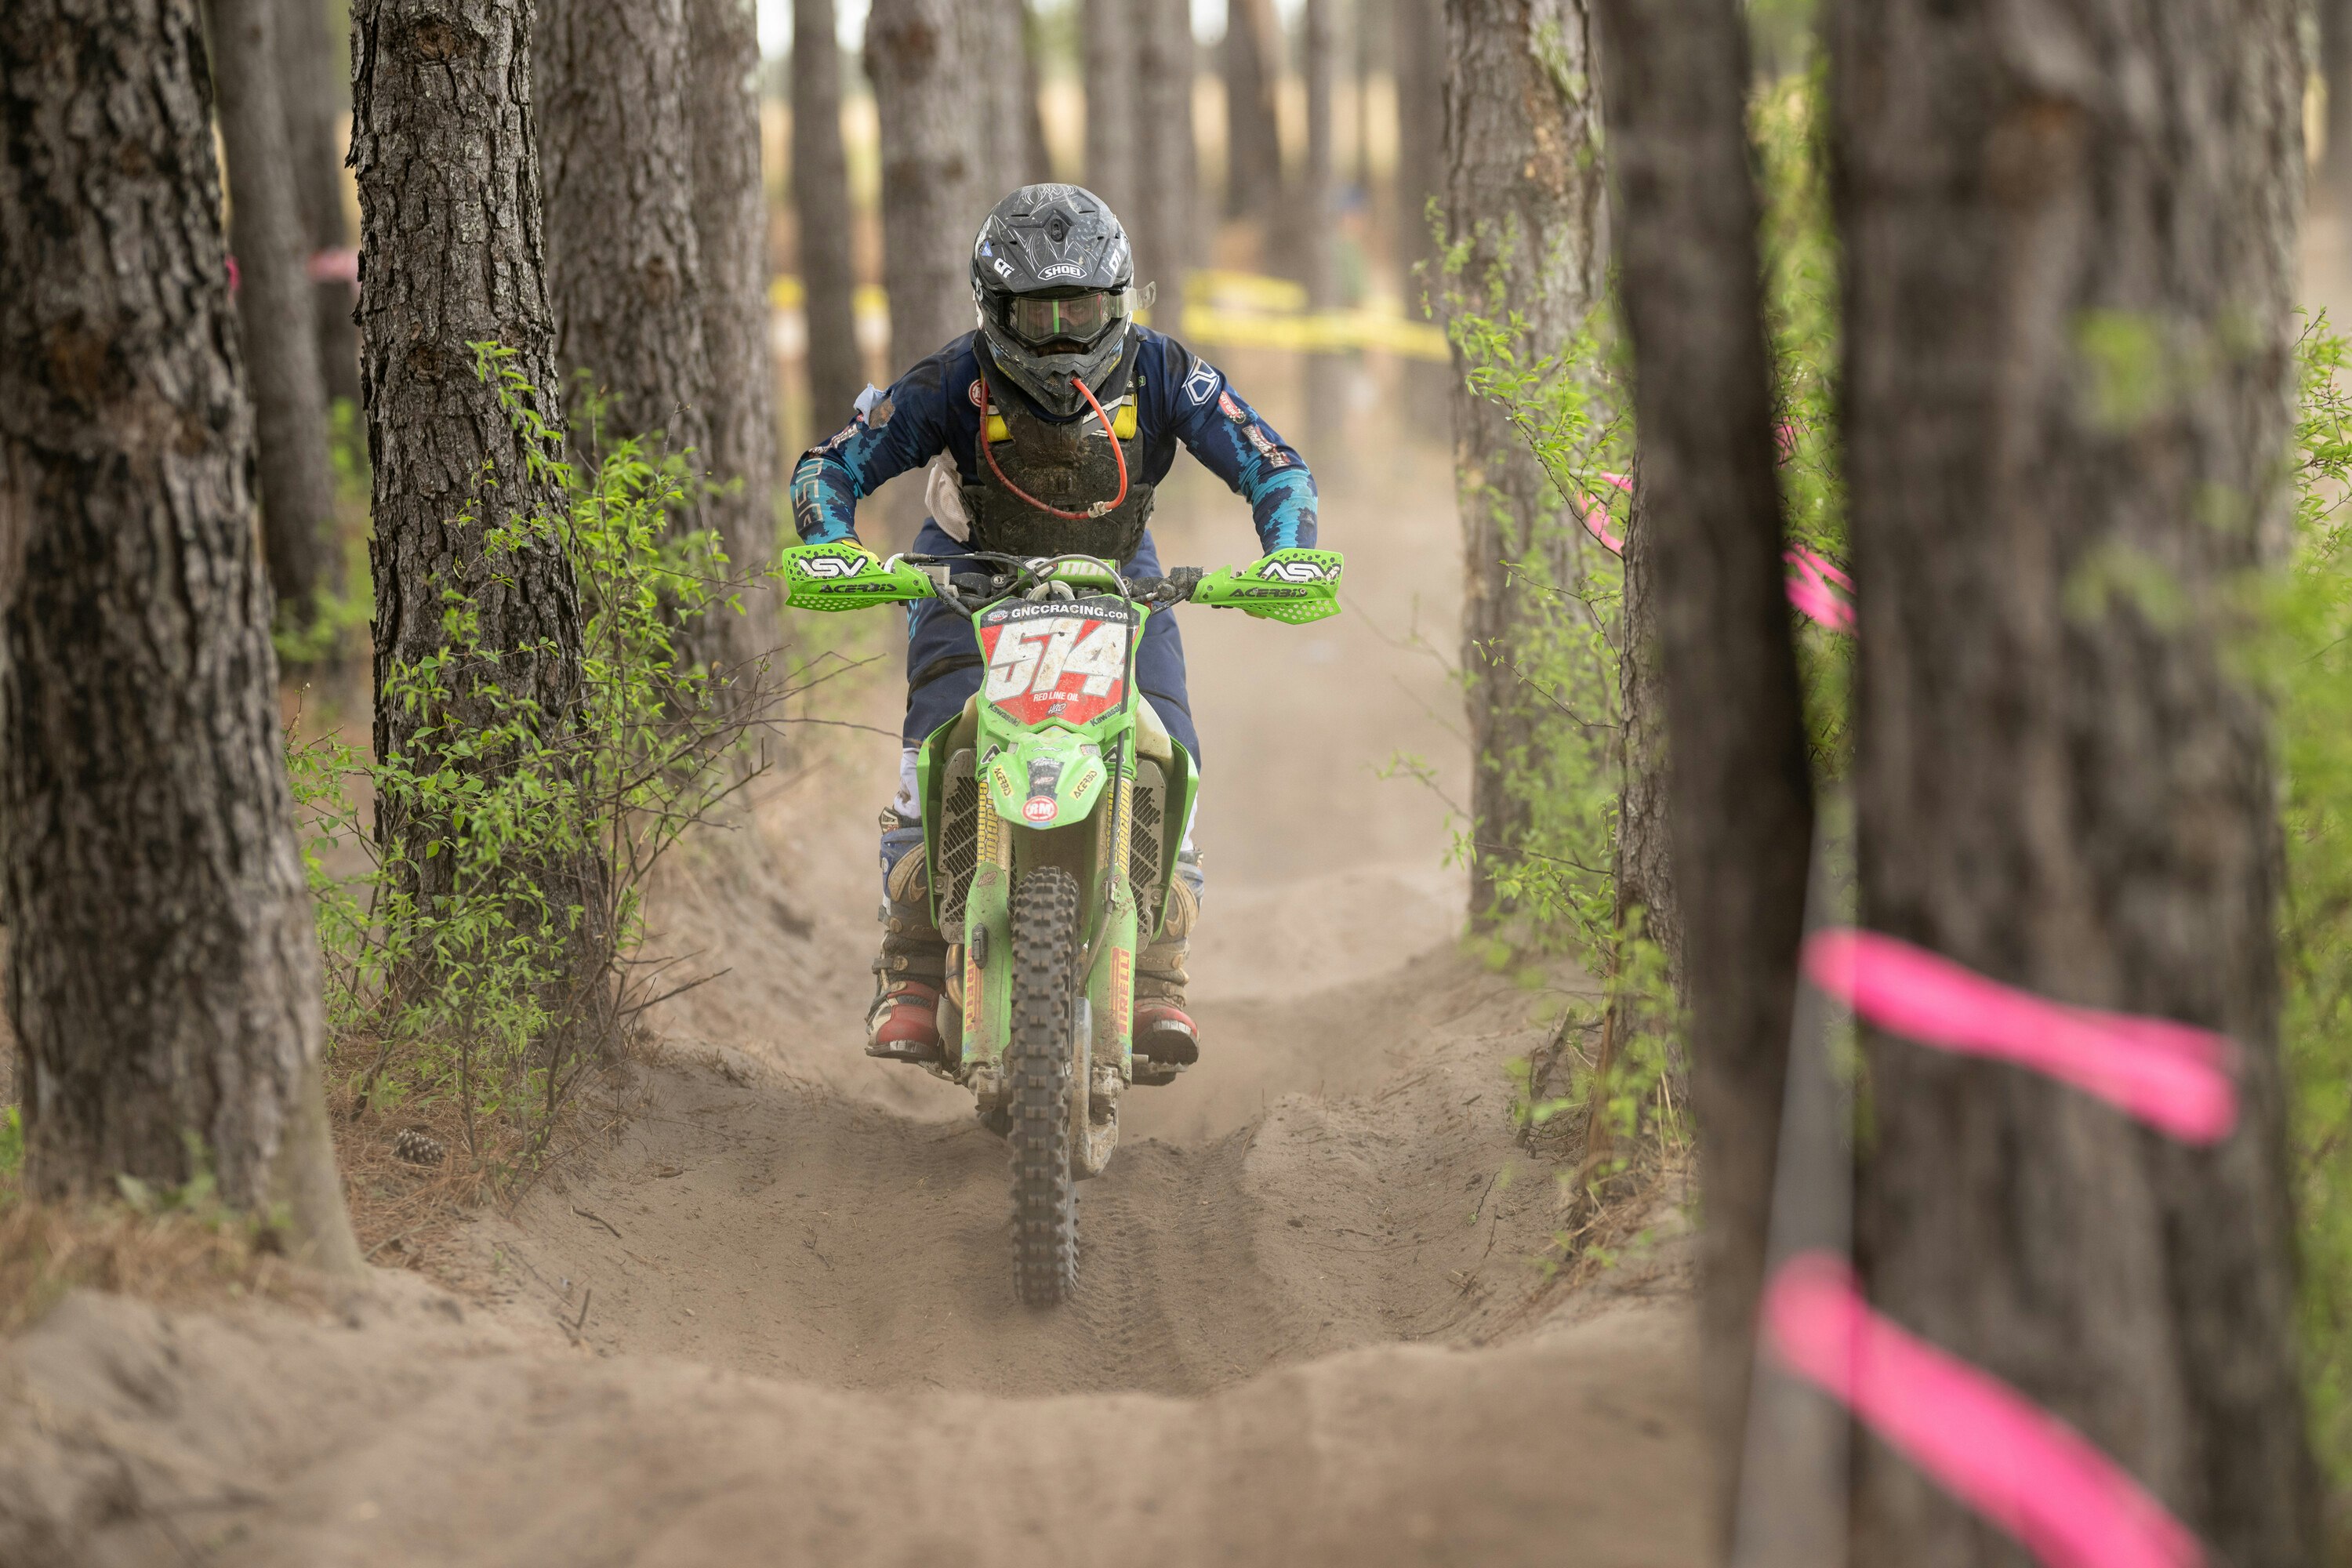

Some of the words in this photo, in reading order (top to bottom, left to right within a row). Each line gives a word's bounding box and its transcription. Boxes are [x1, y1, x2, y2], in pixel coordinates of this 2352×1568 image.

[1044, 266, 1081, 278] SHOEI
[1258, 561, 1341, 583] ASV
[985, 618, 1138, 702] 514
[1033, 692, 1047, 702] RED
[1049, 691, 1066, 700] LINE
[1067, 692, 1079, 702] OIL
[988, 702, 1021, 727] Kawasaki
[1090, 702, 1121, 726] Kawasa
[1110, 946, 1130, 1035] PIRELLI
